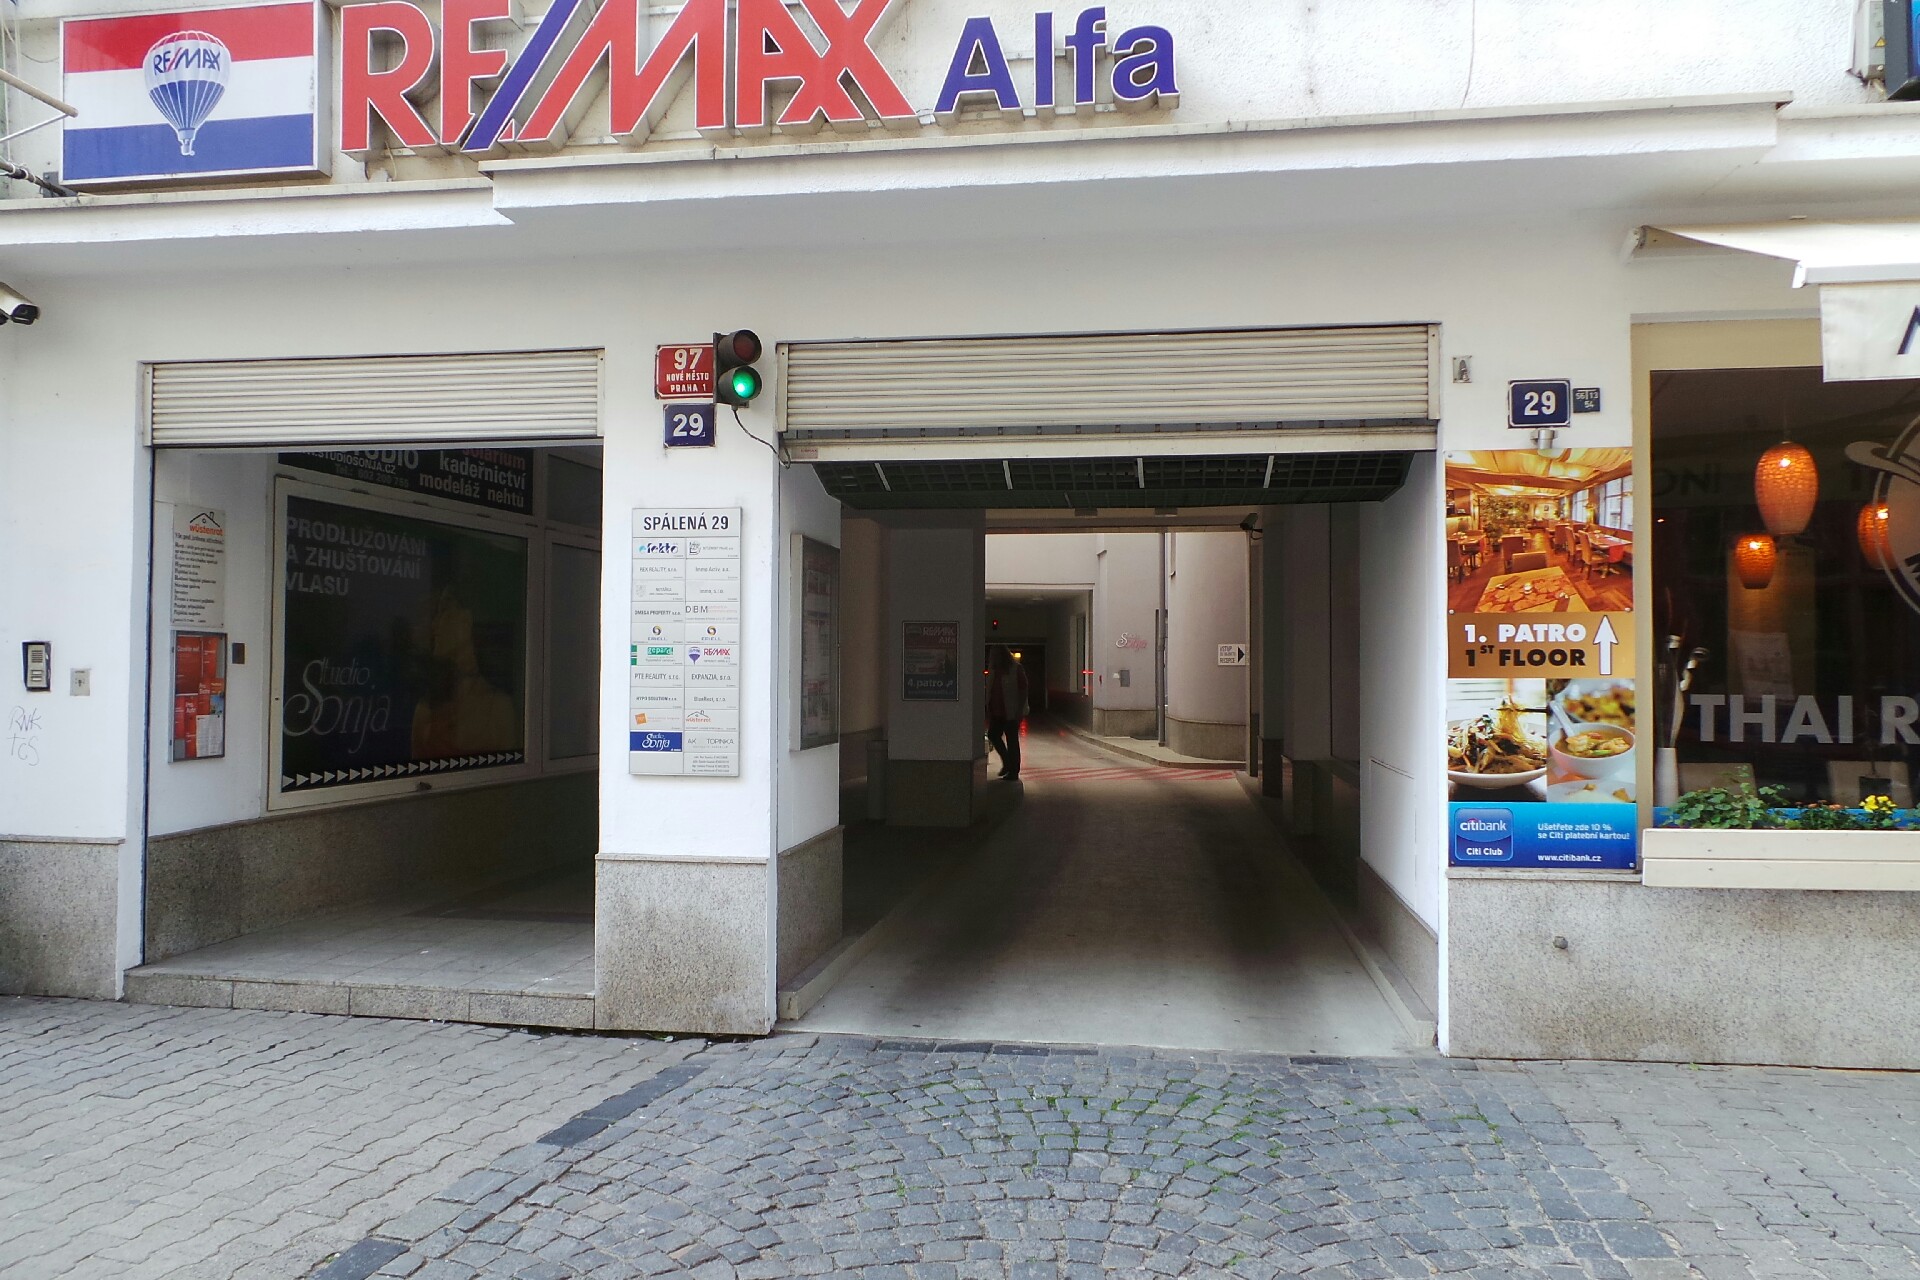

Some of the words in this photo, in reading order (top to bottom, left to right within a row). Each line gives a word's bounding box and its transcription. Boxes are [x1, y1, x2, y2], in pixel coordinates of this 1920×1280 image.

[153, 47, 220, 75] RE/MAX
[340, 0, 917, 152] RE/MAX
[932, 5, 1179, 113] Alfa
[674, 348, 703, 370] 97
[666, 370, 684, 382] NOVÉ
[685, 370, 709, 381] MĚSTO
[670, 383, 698, 392] PRAHA
[702, 384, 707, 392] 1
[1523, 390, 1557, 416] 29
[672, 413, 705, 437] 29
[439, 449, 527, 490] kadeřnictví
[419, 472, 480, 499] modeláž
[643, 512, 708, 531] SPÁLENÁ
[711, 515, 729, 530] 29
[286, 543, 299, 564] A
[1464, 624, 1488, 643] 1.
[1498, 623, 1587, 643] PATRO
[703, 648, 731, 656] RE/MAX
[1498, 648, 1586, 667] FLOOR
[283, 659, 391, 754] Sonja
[1690, 694, 1854, 744] THAI
[642, 733, 671, 752] Sonja
[1459, 819, 1507, 831] citibank
[1537, 822, 1574, 831] Ušetřete
[1575, 823, 1590, 831] zde
[1591, 823, 1600, 831] 10
[1602, 823, 1612, 831] %
[1549, 831, 1564, 839] Citi
[1565, 831, 1598, 840] platební
[1466, 847, 1481, 856] Citi
[1483, 847, 1504, 856] Club
[1537, 853, 1602, 862] www.citibank.cz
